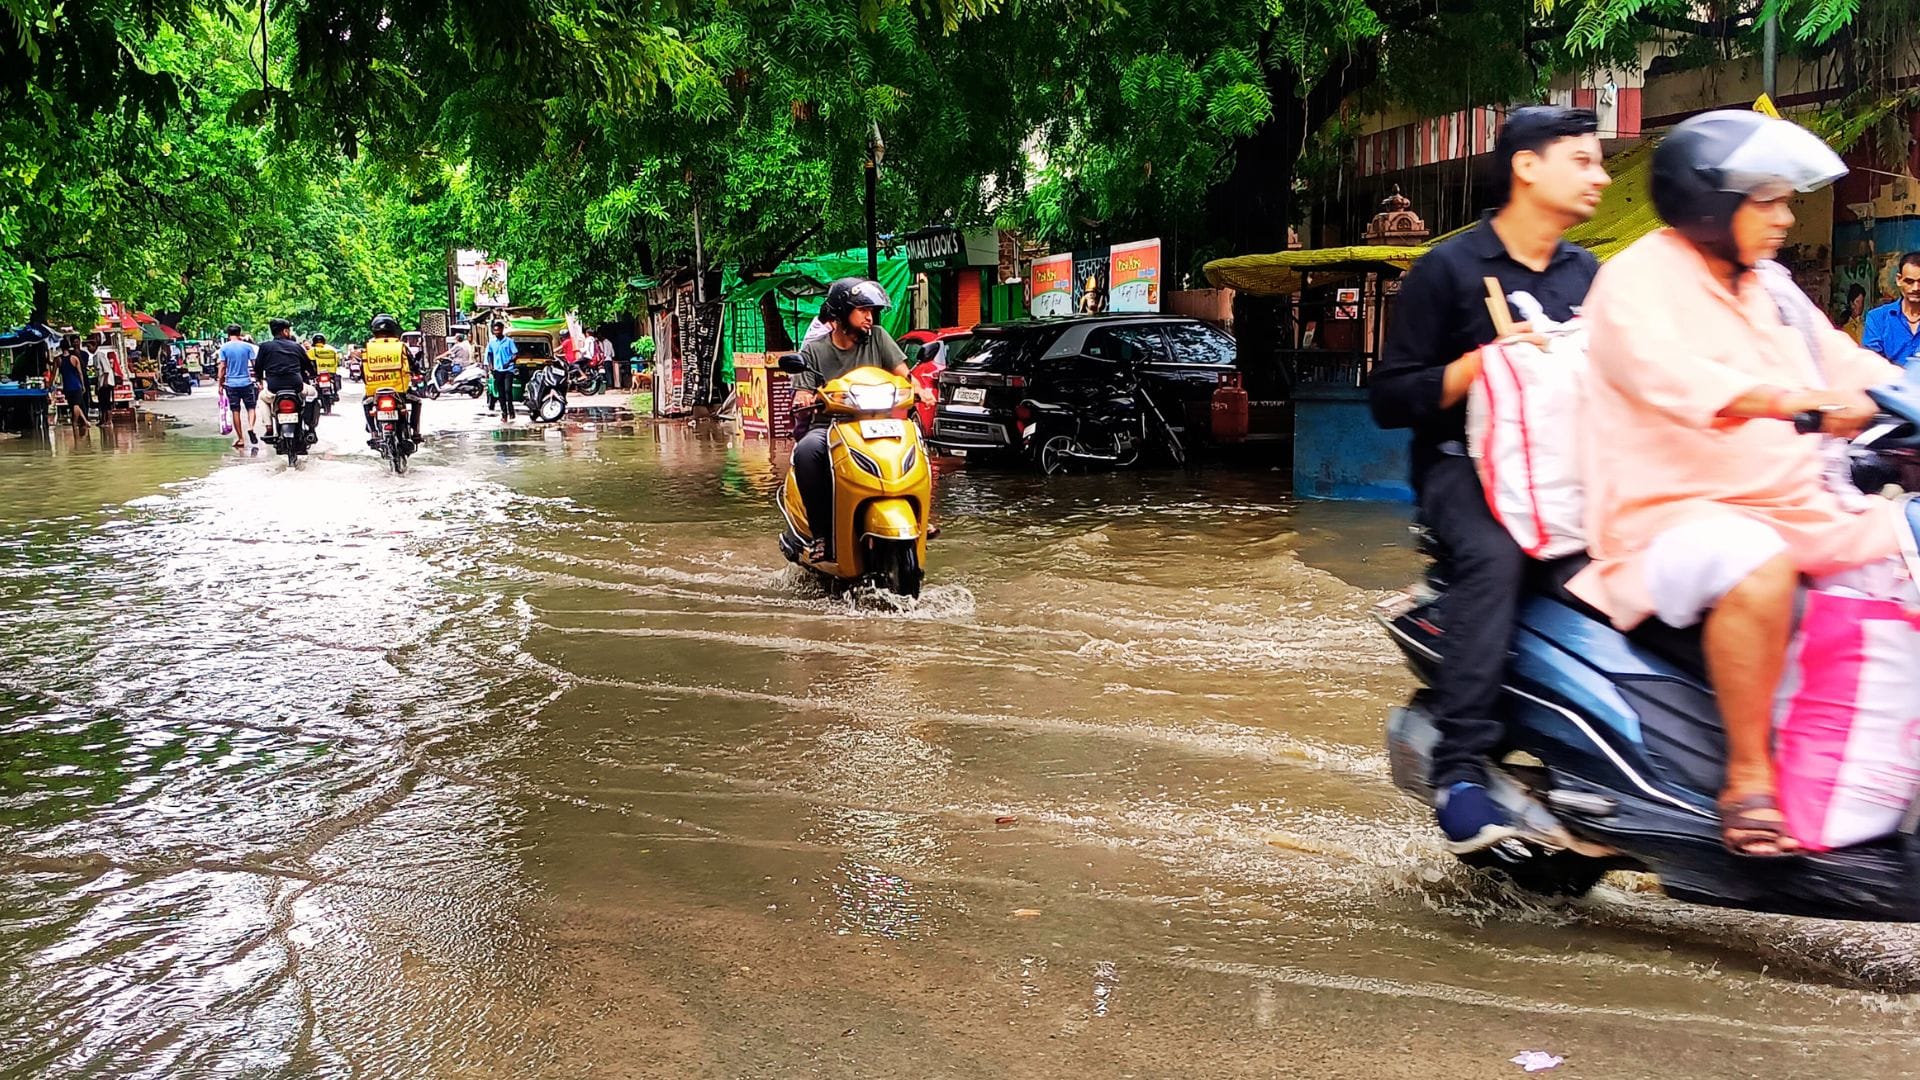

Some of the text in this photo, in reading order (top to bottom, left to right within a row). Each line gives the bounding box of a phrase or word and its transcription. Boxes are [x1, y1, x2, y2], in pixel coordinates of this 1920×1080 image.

[906, 239, 930, 259] SMART
[369, 354, 399, 363] blinkit
[367, 372, 397, 382] blinkit
